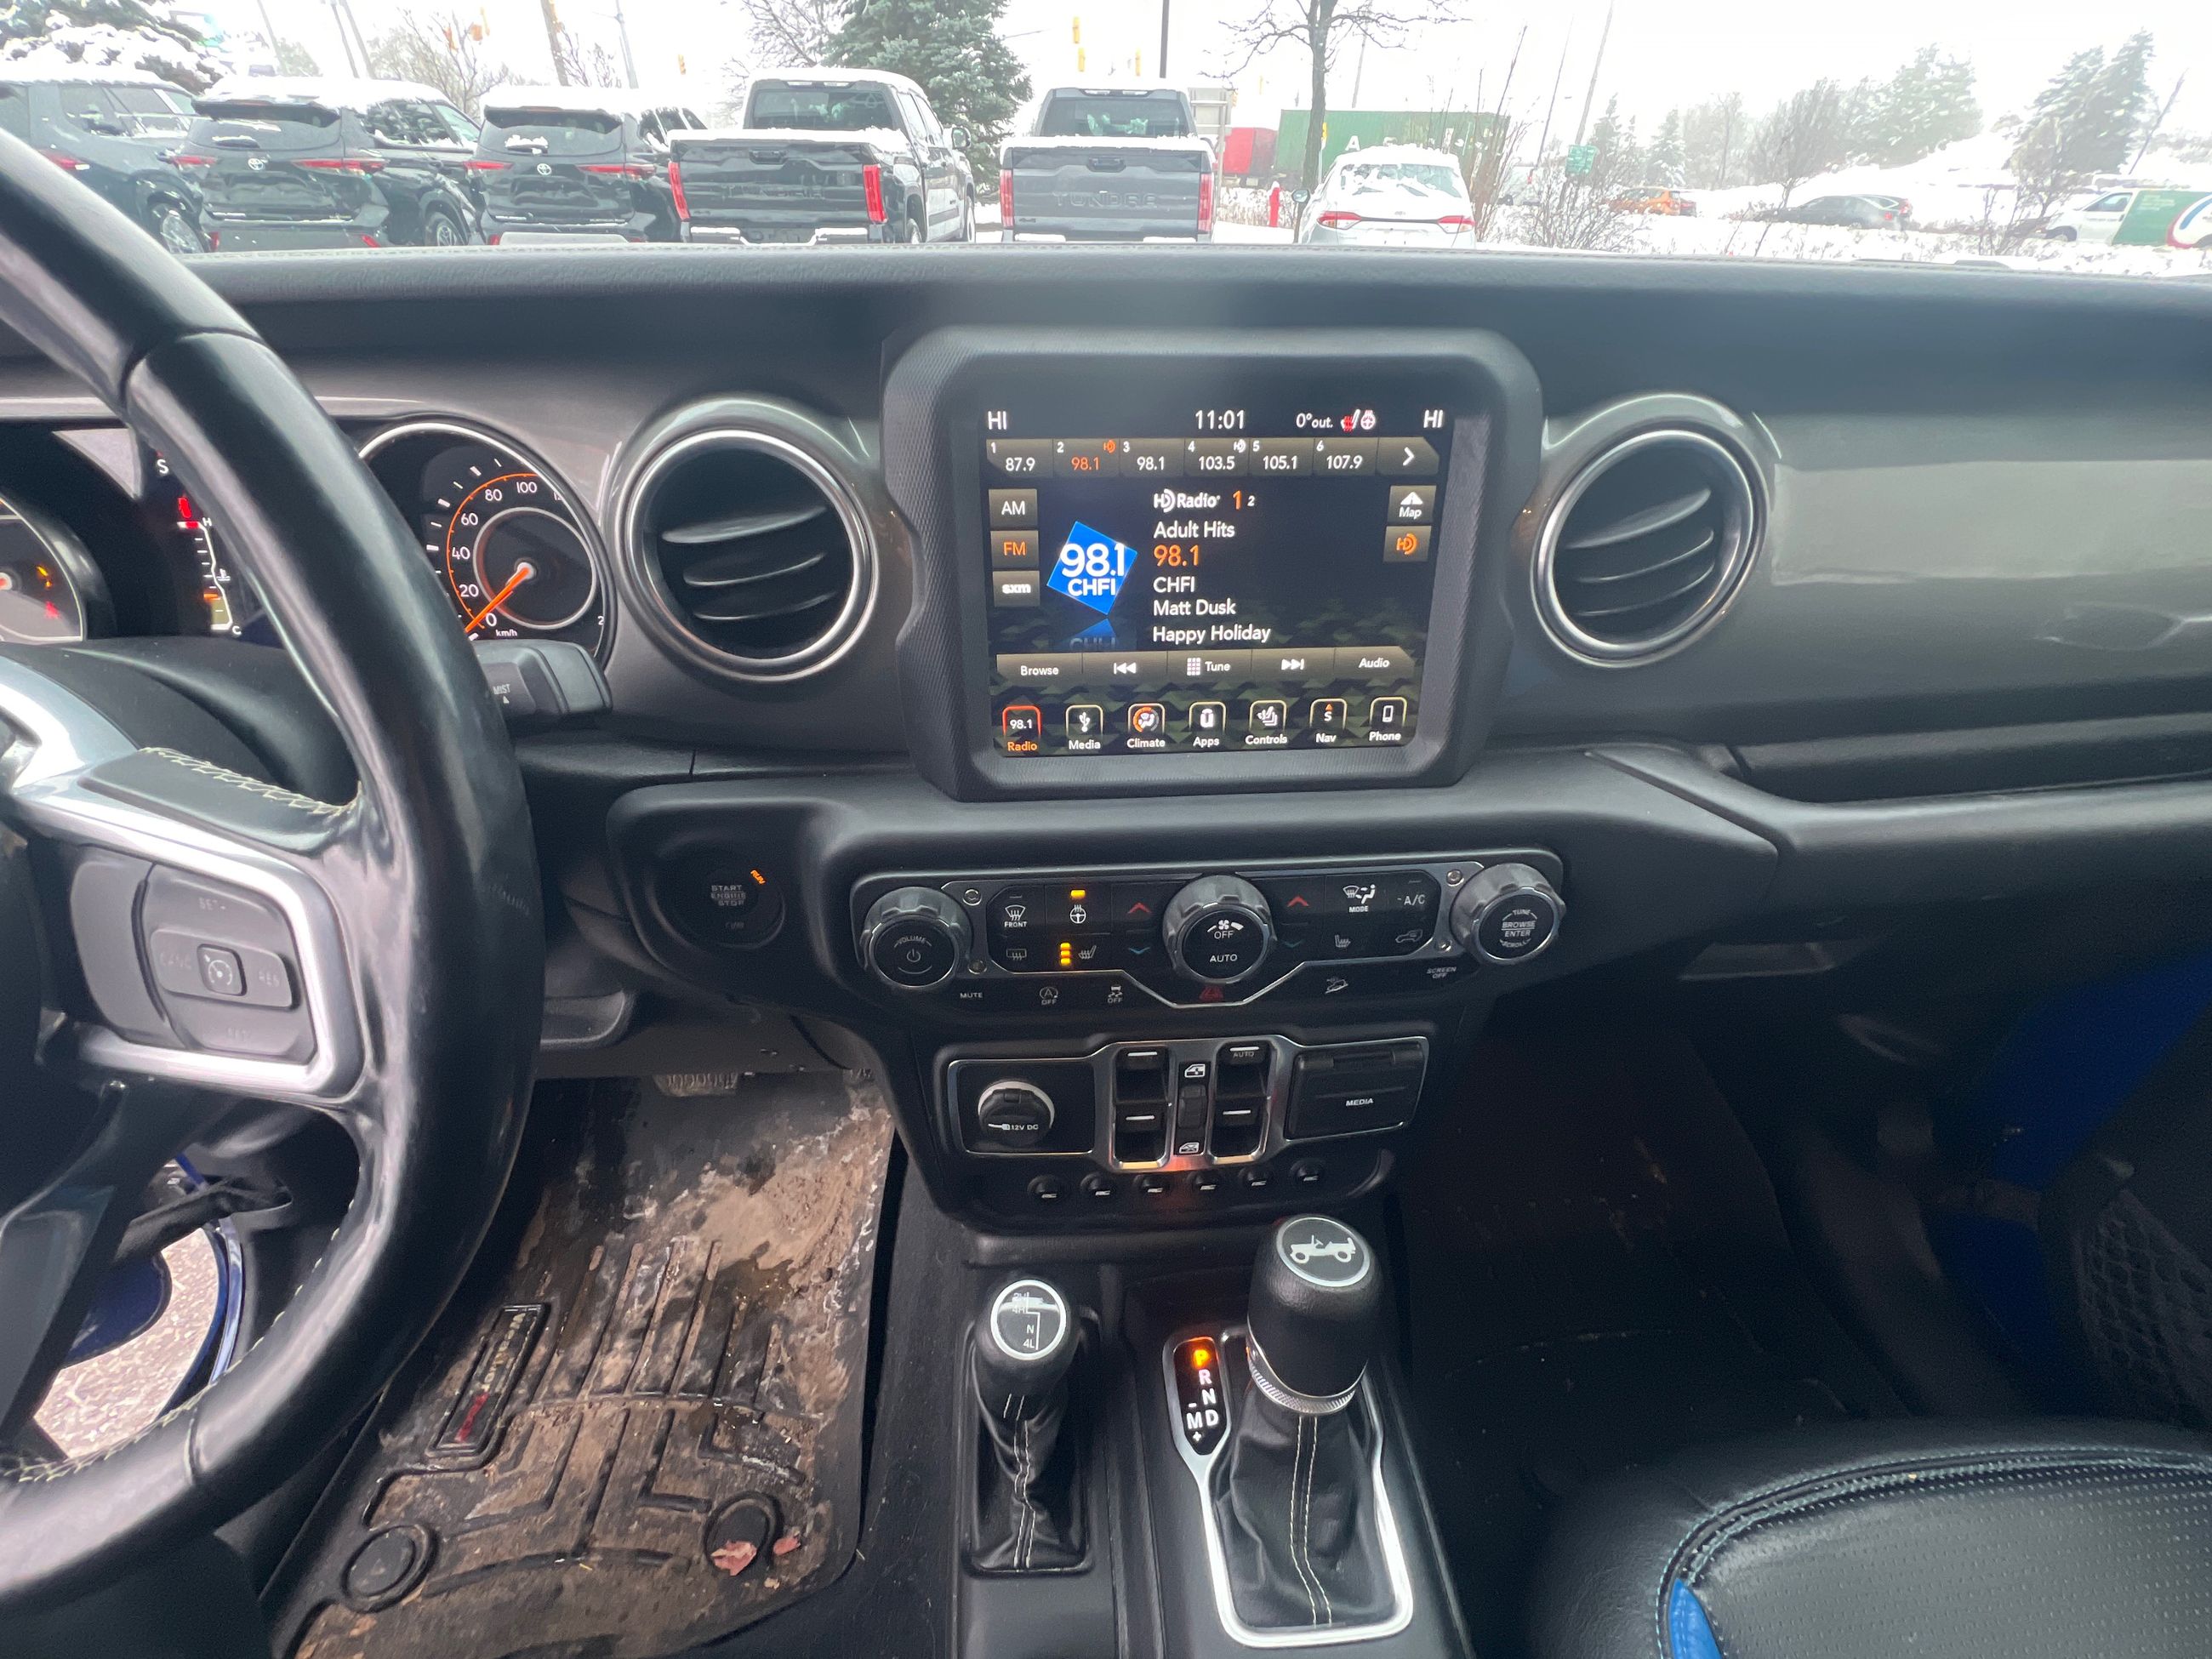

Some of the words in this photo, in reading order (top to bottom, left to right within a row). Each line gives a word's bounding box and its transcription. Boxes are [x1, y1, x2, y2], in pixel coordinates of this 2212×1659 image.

[1052, 191, 1158, 208] TUNDRA
[988, 411, 1007, 430] HI
[1194, 409, 1245, 430] 11:01
[1423, 409, 1444, 429] HI
[990, 442, 996, 453] 1
[1057, 442, 1064, 453] 2
[1123, 442, 1131, 453] 3
[1188, 441, 1195, 452] 4
[1252, 441, 1260, 452] 5
[1316, 441, 1324, 451] 6
[1005, 457, 1035, 471] 87.9
[1071, 457, 1100, 470] 98.1
[1137, 456, 1165, 470] 98.1
[1198, 456, 1235, 470] 103.5
[1263, 455, 1297, 470] 105.1
[1326, 455, 1363, 469] 107.9
[516, 482, 538, 493] 100
[485, 489, 503, 502] 80
[1232, 490, 1242, 510] 1
[1247, 495, 1256, 507] 2
[1001, 501, 1025, 516] AM
[1399, 507, 1422, 519] Map
[460, 513, 478, 526] 60
[1153, 520, 1199, 539] Adult
[1203, 520, 1235, 539] Hits
[452, 546, 470, 560] 40
[1003, 541, 1026, 556] FM
[1059, 543, 1126, 578] 98.1
[1154, 544, 1200, 567] 98.1
[459, 584, 479, 597] 20
[1002, 584, 1031, 594] sxm
[1067, 579, 1117, 597] CHFI
[1153, 576, 1195, 593] CHFI
[1153, 600, 1191, 617] Matt
[1195, 597, 1236, 616] Dusk
[485, 613, 497, 627] 0
[495, 629, 517, 637] km/h
[1153, 626, 1206, 645] Happy
[1211, 624, 1272, 643] Holiday
[1205, 661, 1231, 672] Tune
[1359, 658, 1390, 668] Audio
[1020, 665, 1059, 676] Browse
[493, 684, 510, 694] MIST
[1010, 719, 1033, 729] 98.1
[1193, 737, 1220, 747] Apps
[1245, 734, 1287, 744] Controls
[1315, 733, 1337, 743] Nav
[1369, 731, 1401, 741] Phone
[1007, 742, 1038, 752] Radio
[1069, 739, 1101, 750] Media
[1126, 738, 1166, 749] Climate
[1404, 894, 1425, 906] A/C
[898, 935, 926, 945] VOLUME
[1214, 931, 1234, 940] OFF
[1209, 954, 1238, 963] AUTO
[1345, 1097, 1374, 1106] MEDIA
[1026, 1324, 1035, 1334] N
[1023, 1339, 1035, 1348] 4L
[1194, 1349, 1209, 1366] P
[1199, 1369, 1212, 1385] R
[1201, 1388, 1217, 1405] N
[1186, 1411, 1203, 1429] M
[1206, 1410, 1219, 1426] D
